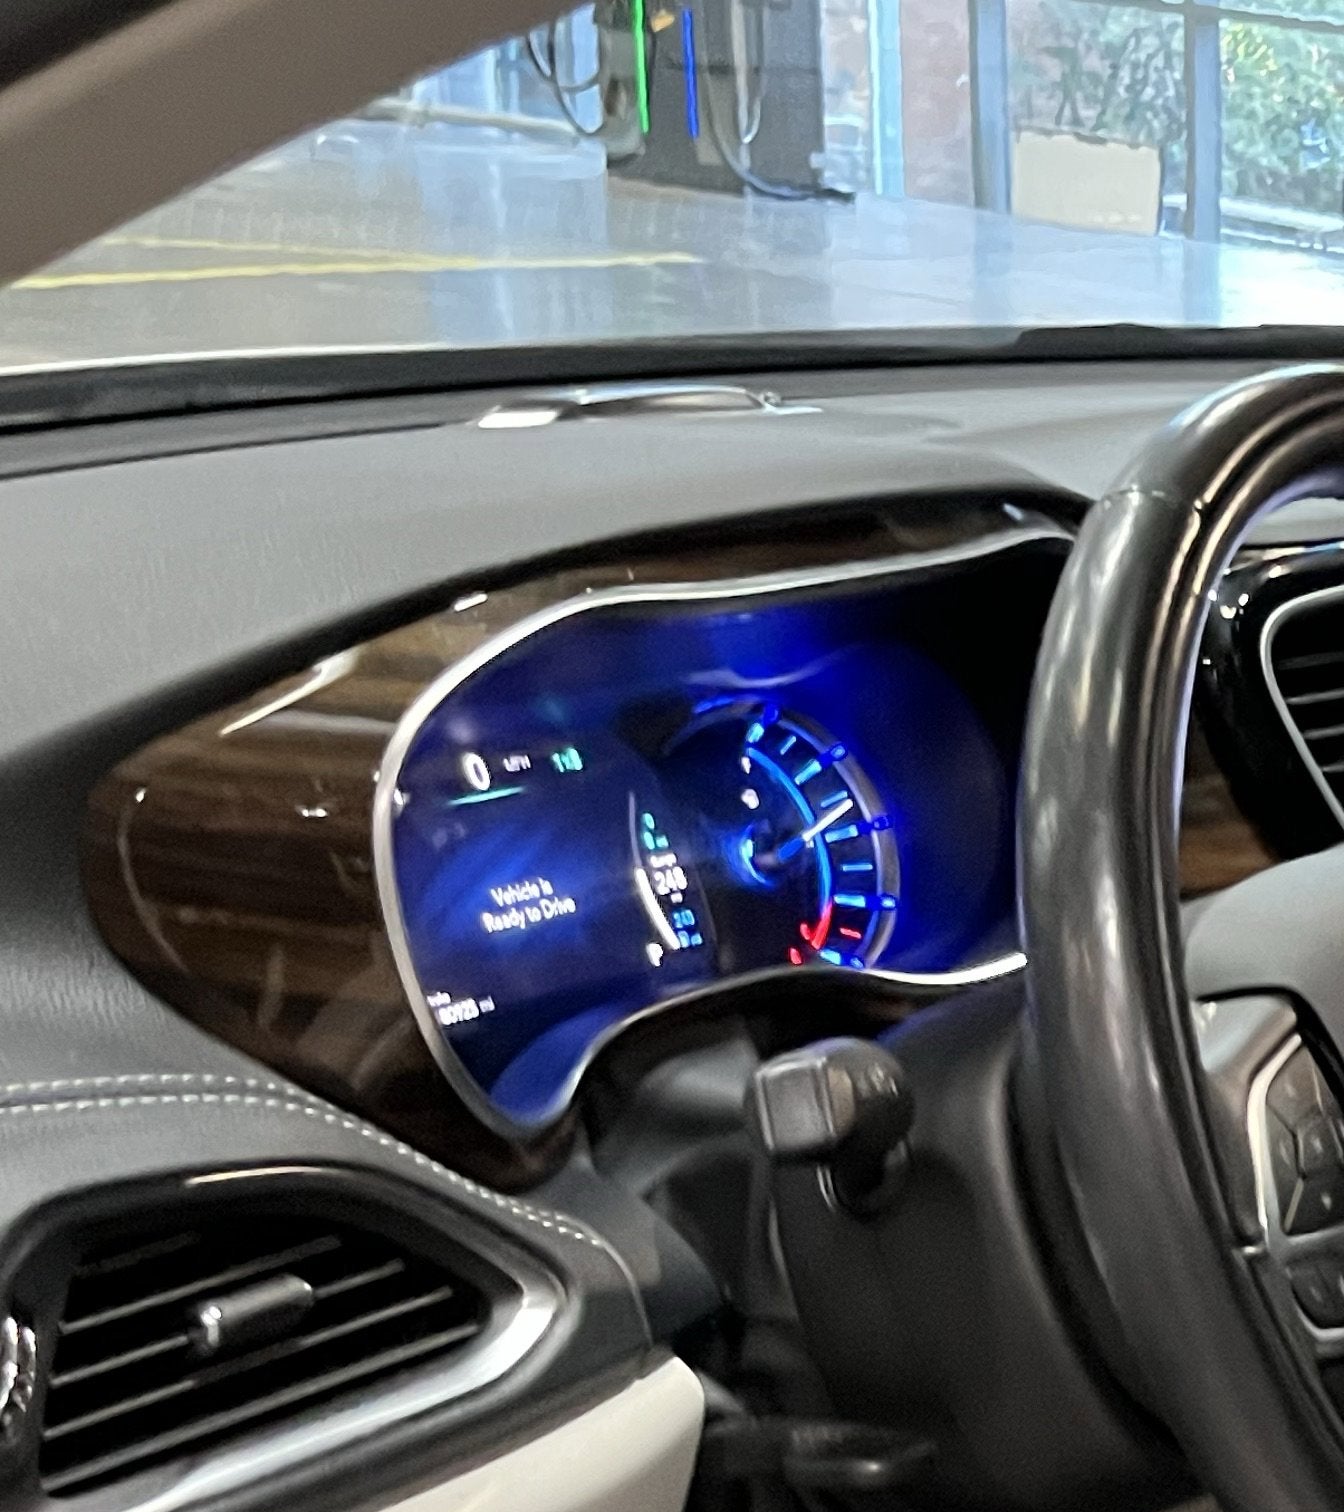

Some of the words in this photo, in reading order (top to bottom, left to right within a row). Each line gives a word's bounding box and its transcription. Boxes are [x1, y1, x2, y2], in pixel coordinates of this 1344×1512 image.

[463, 752, 490, 790] 0
[490, 881, 540, 907] Vehicle
[482, 908, 526, 933] Ready
[525, 906, 542, 923] to
[540, 896, 577, 919] Drive
